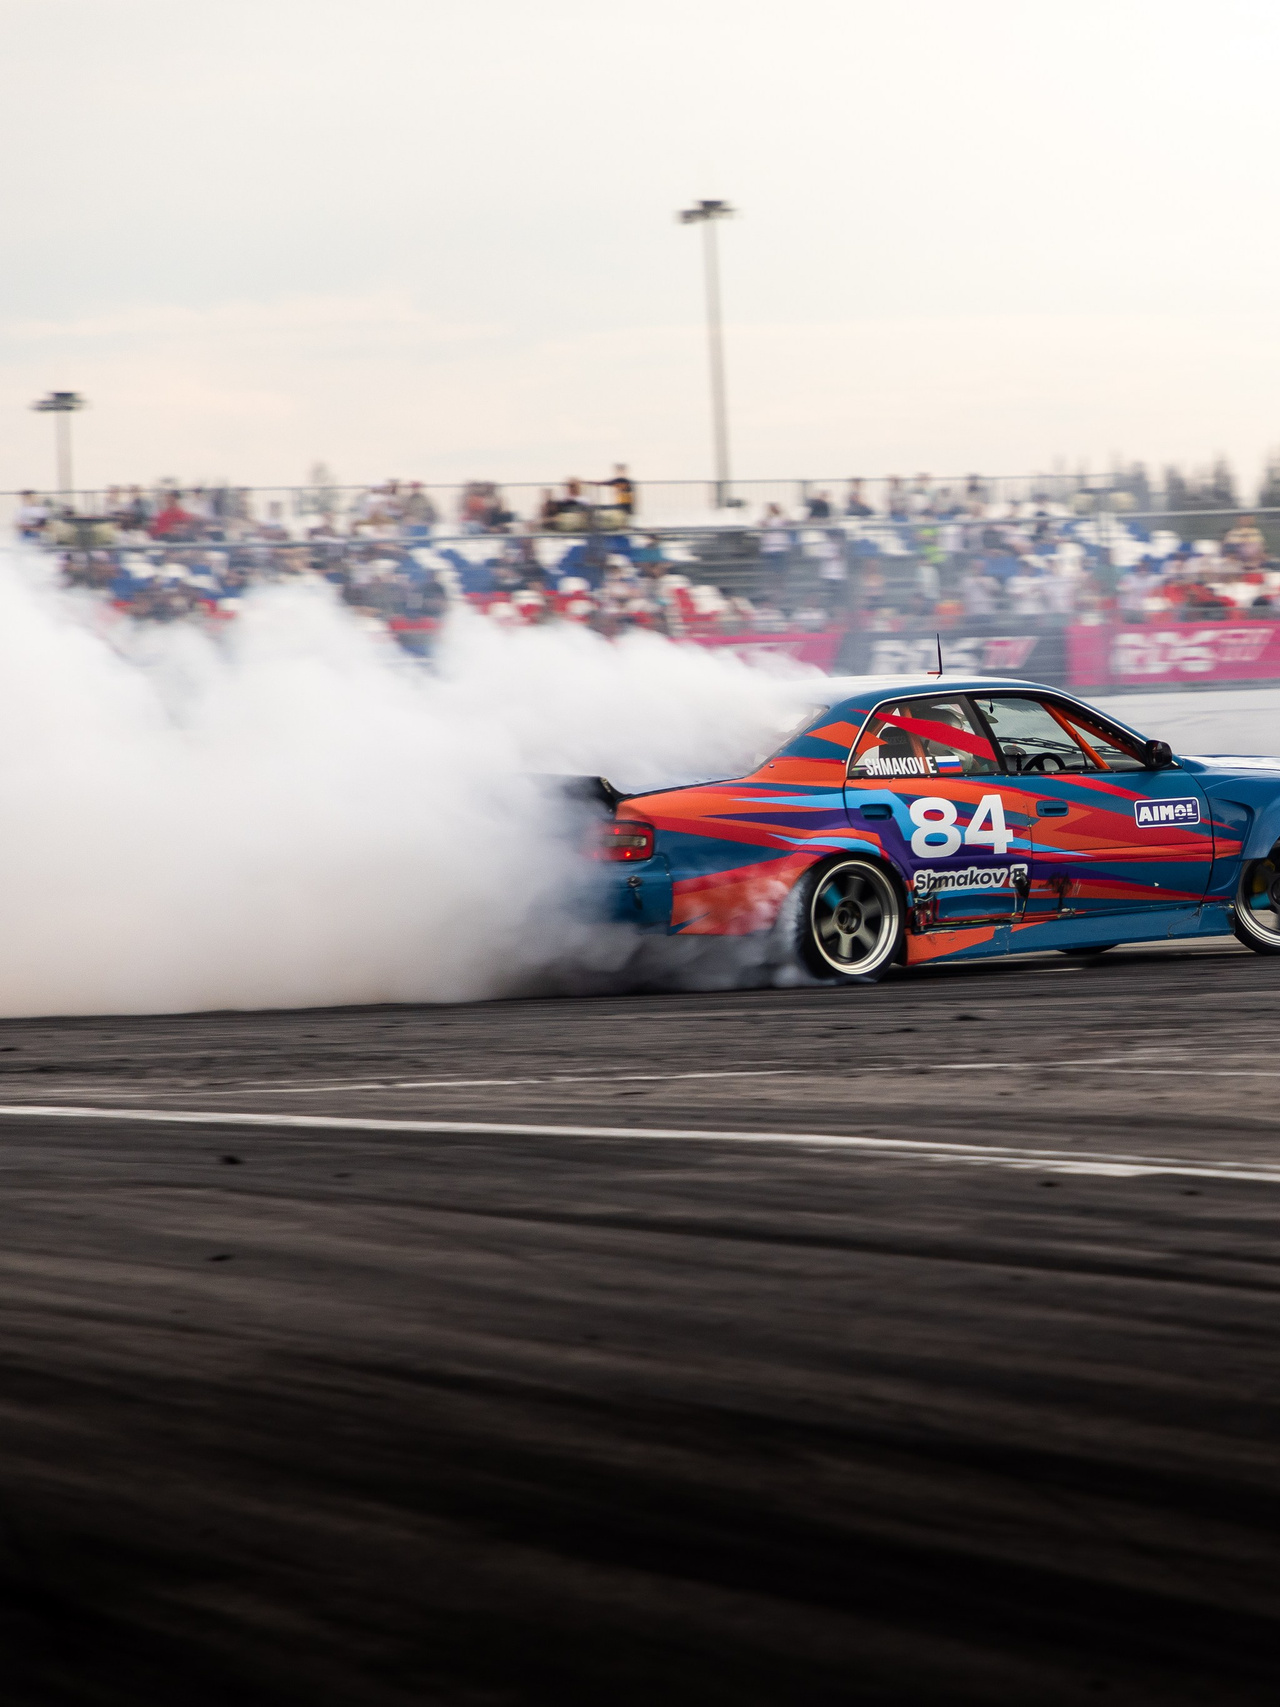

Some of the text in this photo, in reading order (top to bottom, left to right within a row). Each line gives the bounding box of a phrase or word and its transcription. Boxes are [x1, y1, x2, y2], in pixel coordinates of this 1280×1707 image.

[865, 756, 937, 776] SHMAKOV E
[1139, 803, 1197, 823] AIMOL
[909, 793, 1014, 858] 84
[915, 869, 1005, 892] Shmakov
